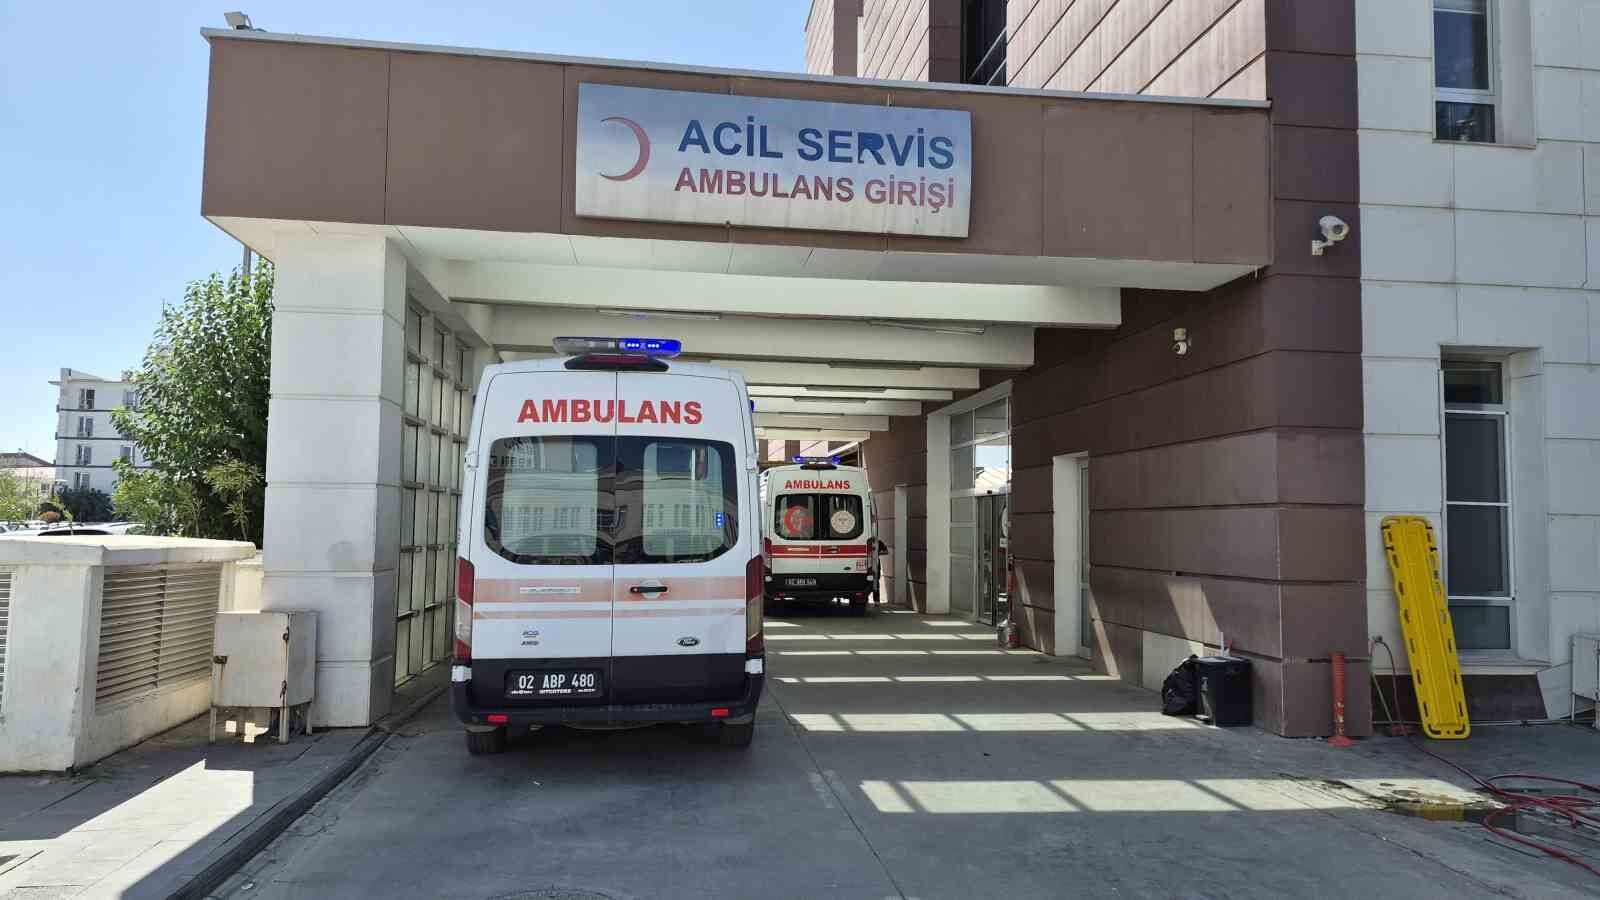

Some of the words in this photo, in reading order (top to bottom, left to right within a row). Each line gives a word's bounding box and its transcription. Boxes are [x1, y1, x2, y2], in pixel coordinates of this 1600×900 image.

[677, 115, 784, 160] ACİL
[796, 127, 955, 171] SERVİS
[674, 166, 855, 202] AMBULANS
[864, 174, 955, 214] GİRİŞİ
[516, 399, 703, 425] AMBULANS
[784, 479, 851, 490] AMBULANS
[518, 674, 535, 689] 02
[542, 673, 566, 689] ABP
[571, 672, 594, 688] 480
